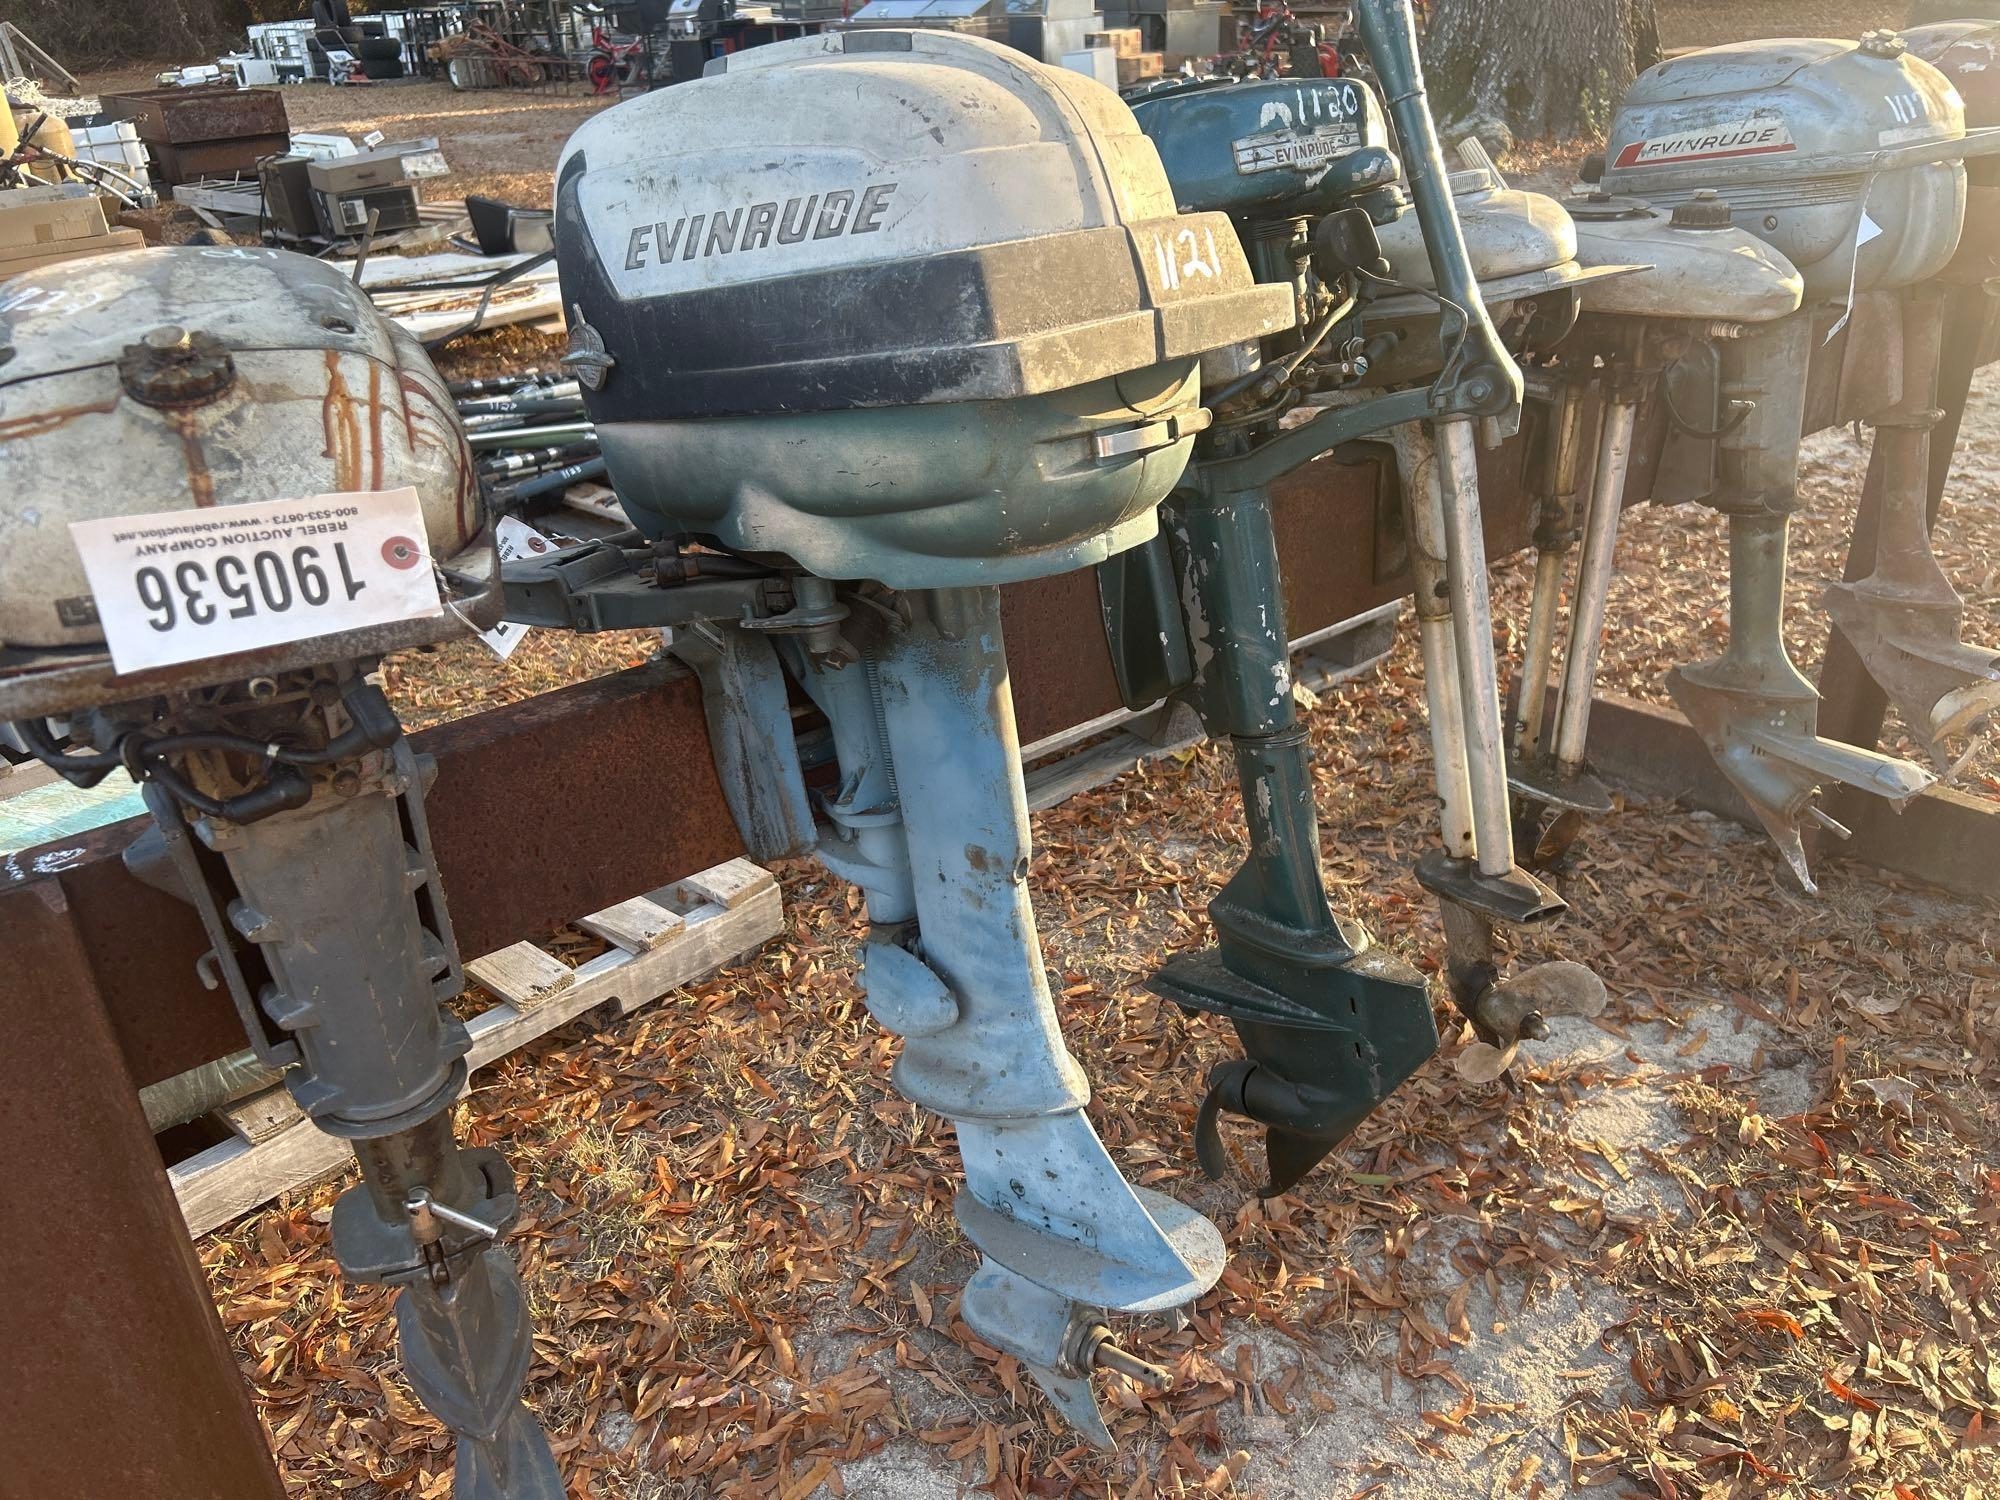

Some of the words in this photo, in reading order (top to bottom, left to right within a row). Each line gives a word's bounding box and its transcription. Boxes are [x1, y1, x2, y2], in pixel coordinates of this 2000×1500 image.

[1296, 85, 1358, 126] 1120
[1275, 139, 1337, 163] EVINRUDE
[625, 183, 898, 270] EVINRUDE
[1153, 226, 1222, 290] 1121
[273, 507, 359, 525] 800-533-0673
[303, 521, 348, 536] REBEL
[113, 517, 262, 543] www.rebelauction.net
[223, 527, 292, 545] AUCTION
[135, 536, 218, 557] COMPANY
[136, 541, 366, 632] 190536
